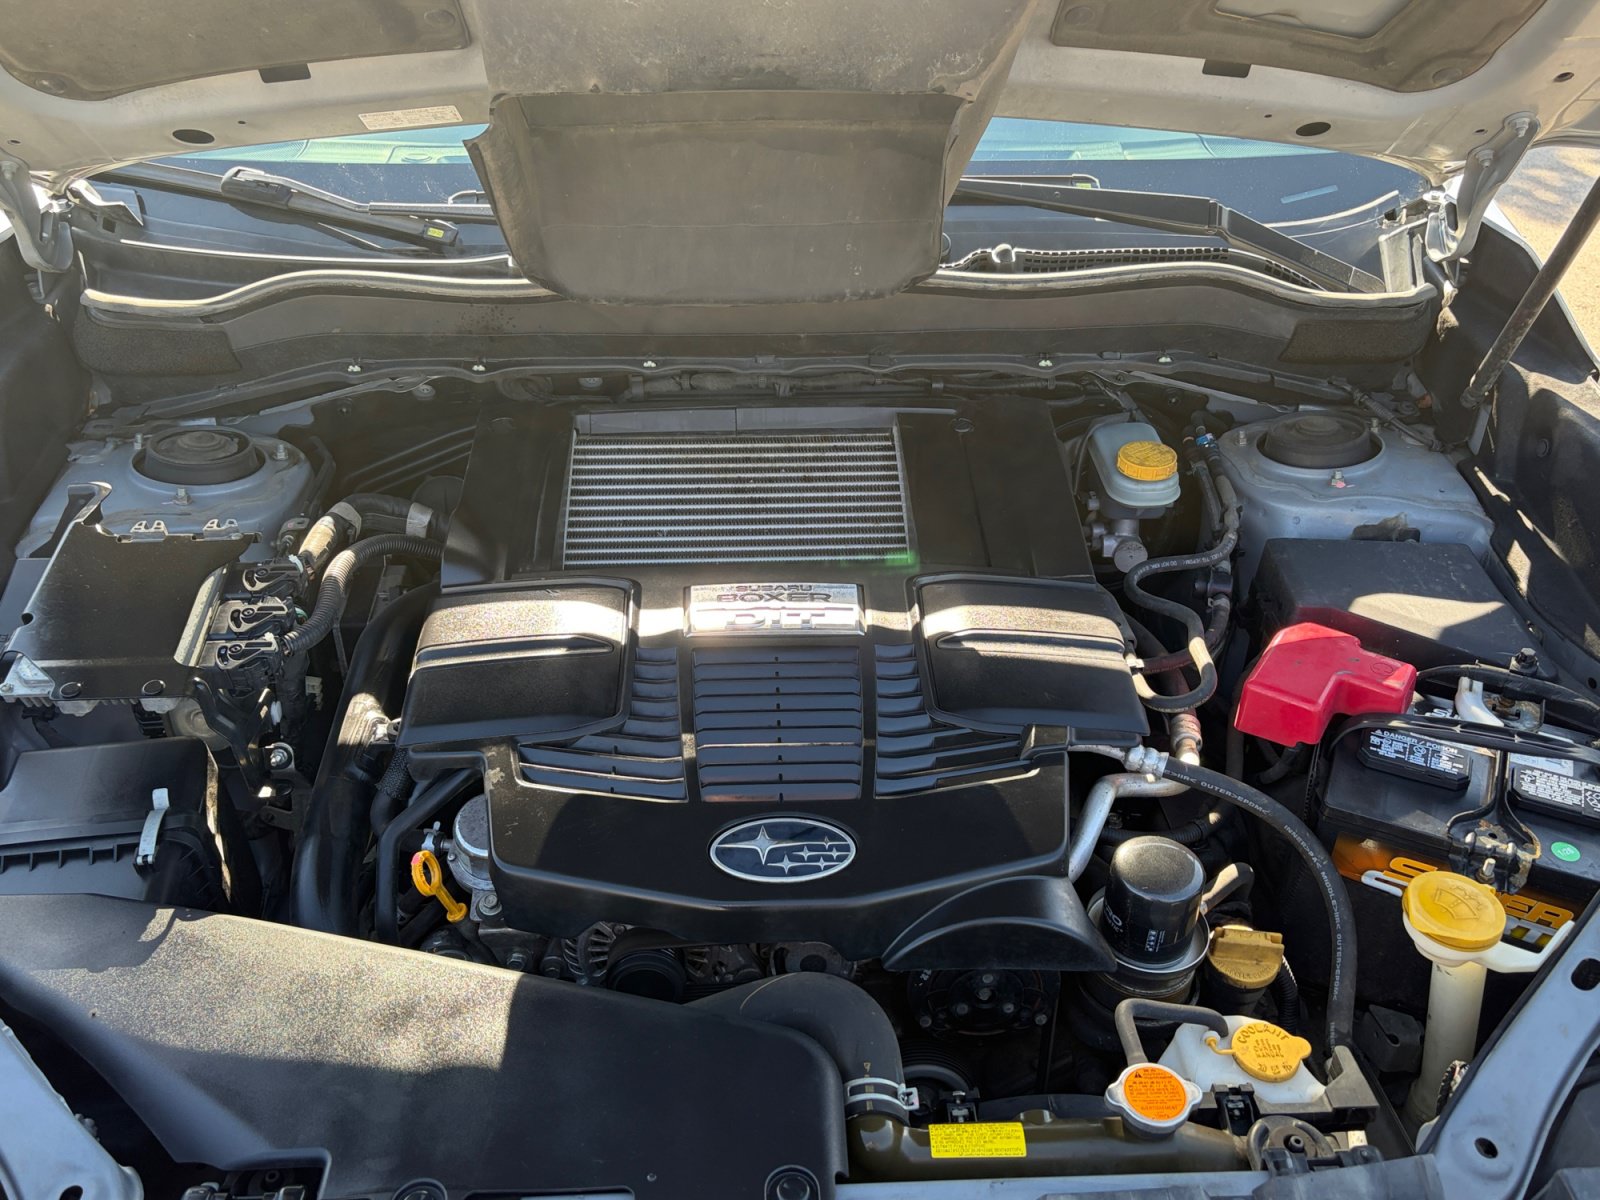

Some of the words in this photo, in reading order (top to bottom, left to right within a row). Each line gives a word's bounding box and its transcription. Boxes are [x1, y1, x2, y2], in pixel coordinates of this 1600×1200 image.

[735, 584, 813, 592] SUBARU
[716, 592, 832, 603] BOXER
[1383, 730, 1418, 744] DANGER
[1426, 742, 1459, 755] POISON
